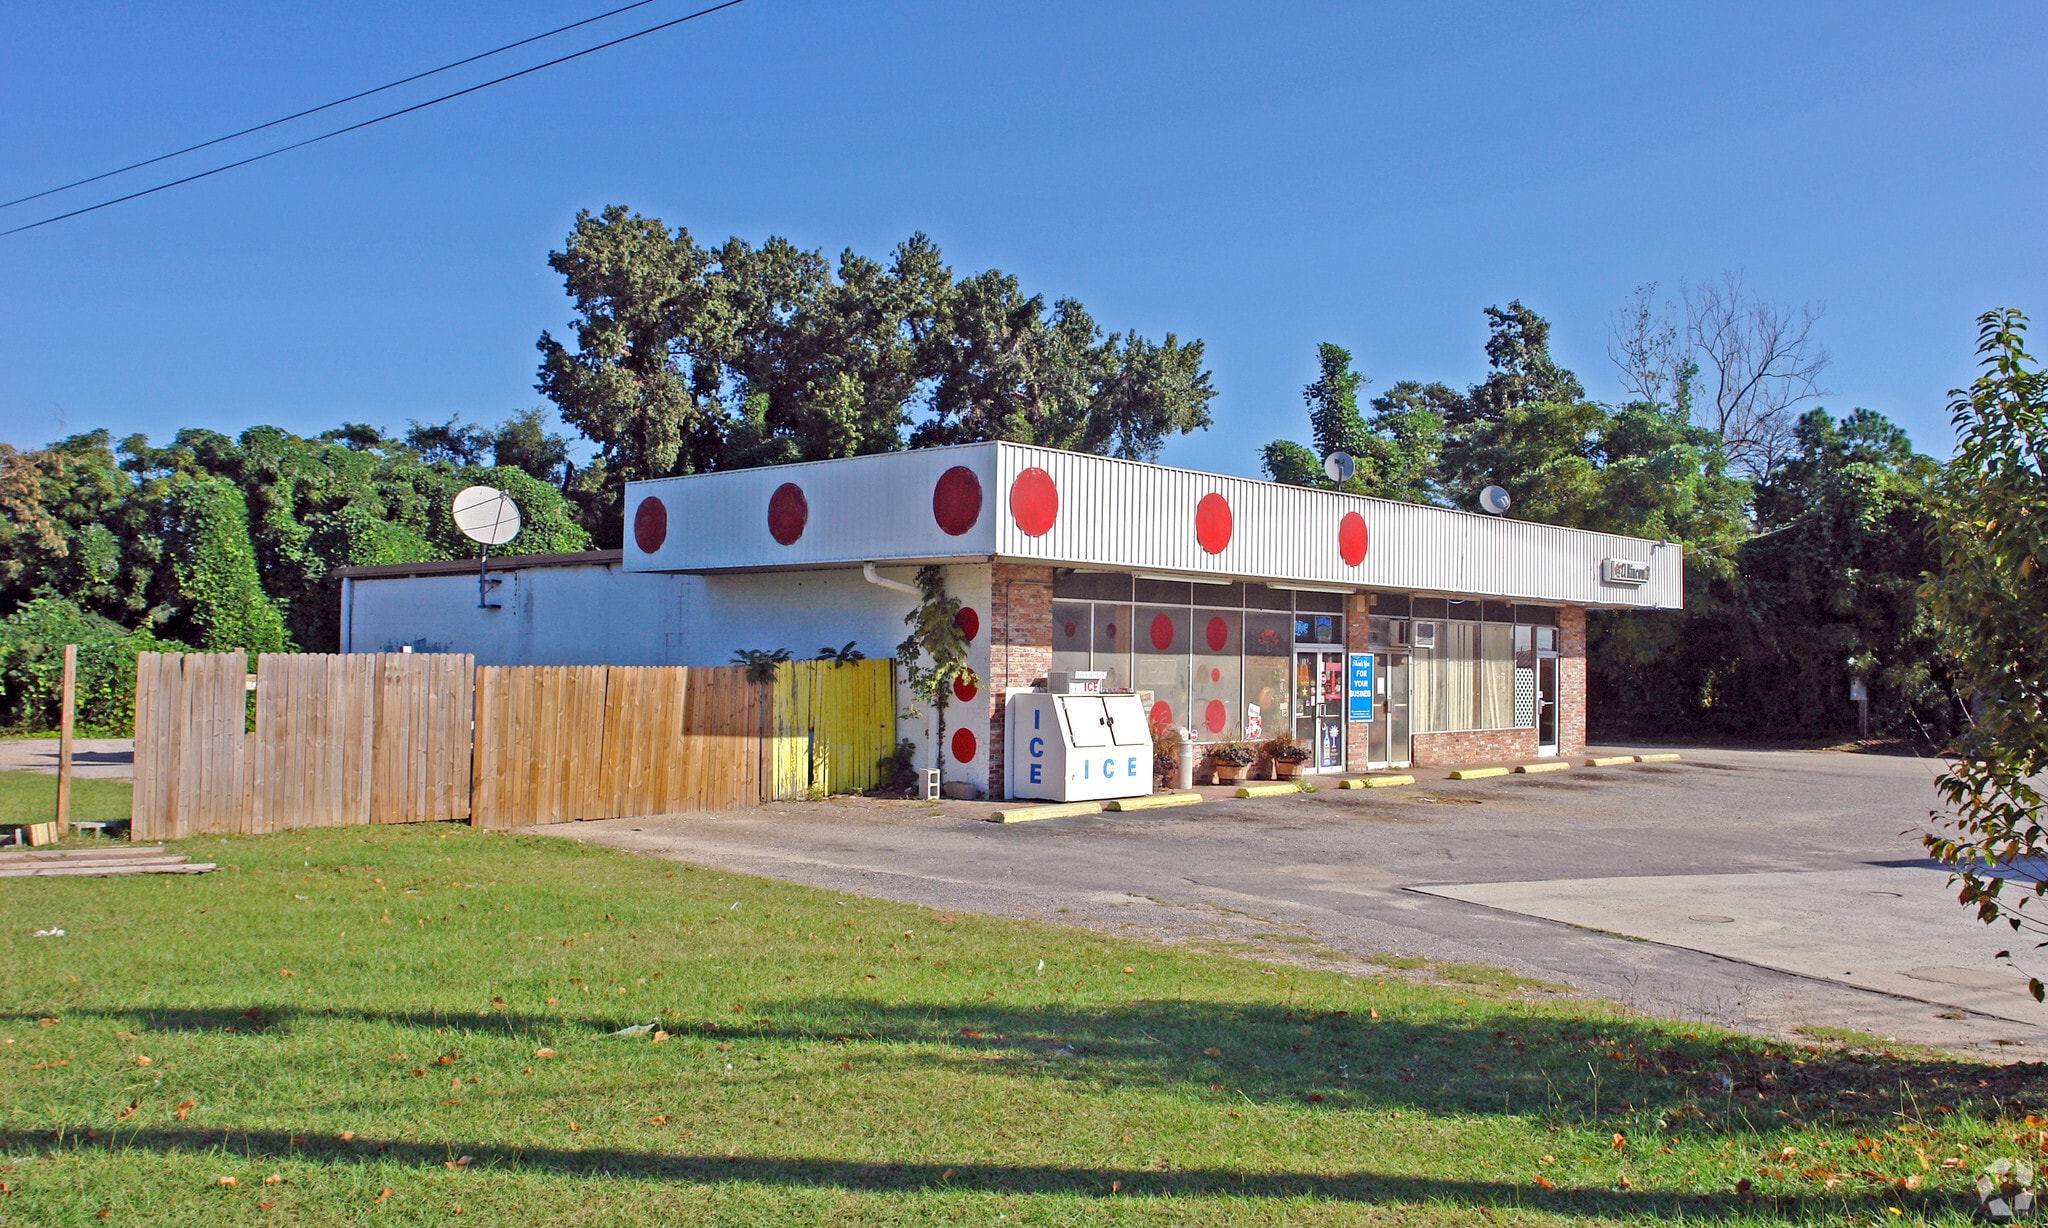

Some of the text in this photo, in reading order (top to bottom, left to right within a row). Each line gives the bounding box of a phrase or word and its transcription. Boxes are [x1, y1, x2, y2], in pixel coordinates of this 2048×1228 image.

[1356, 669, 1367, 677] FOR
[1084, 681, 1099, 692] ICE
[1029, 709, 1044, 785] ICE
[1084, 757, 1137, 780] ICE
